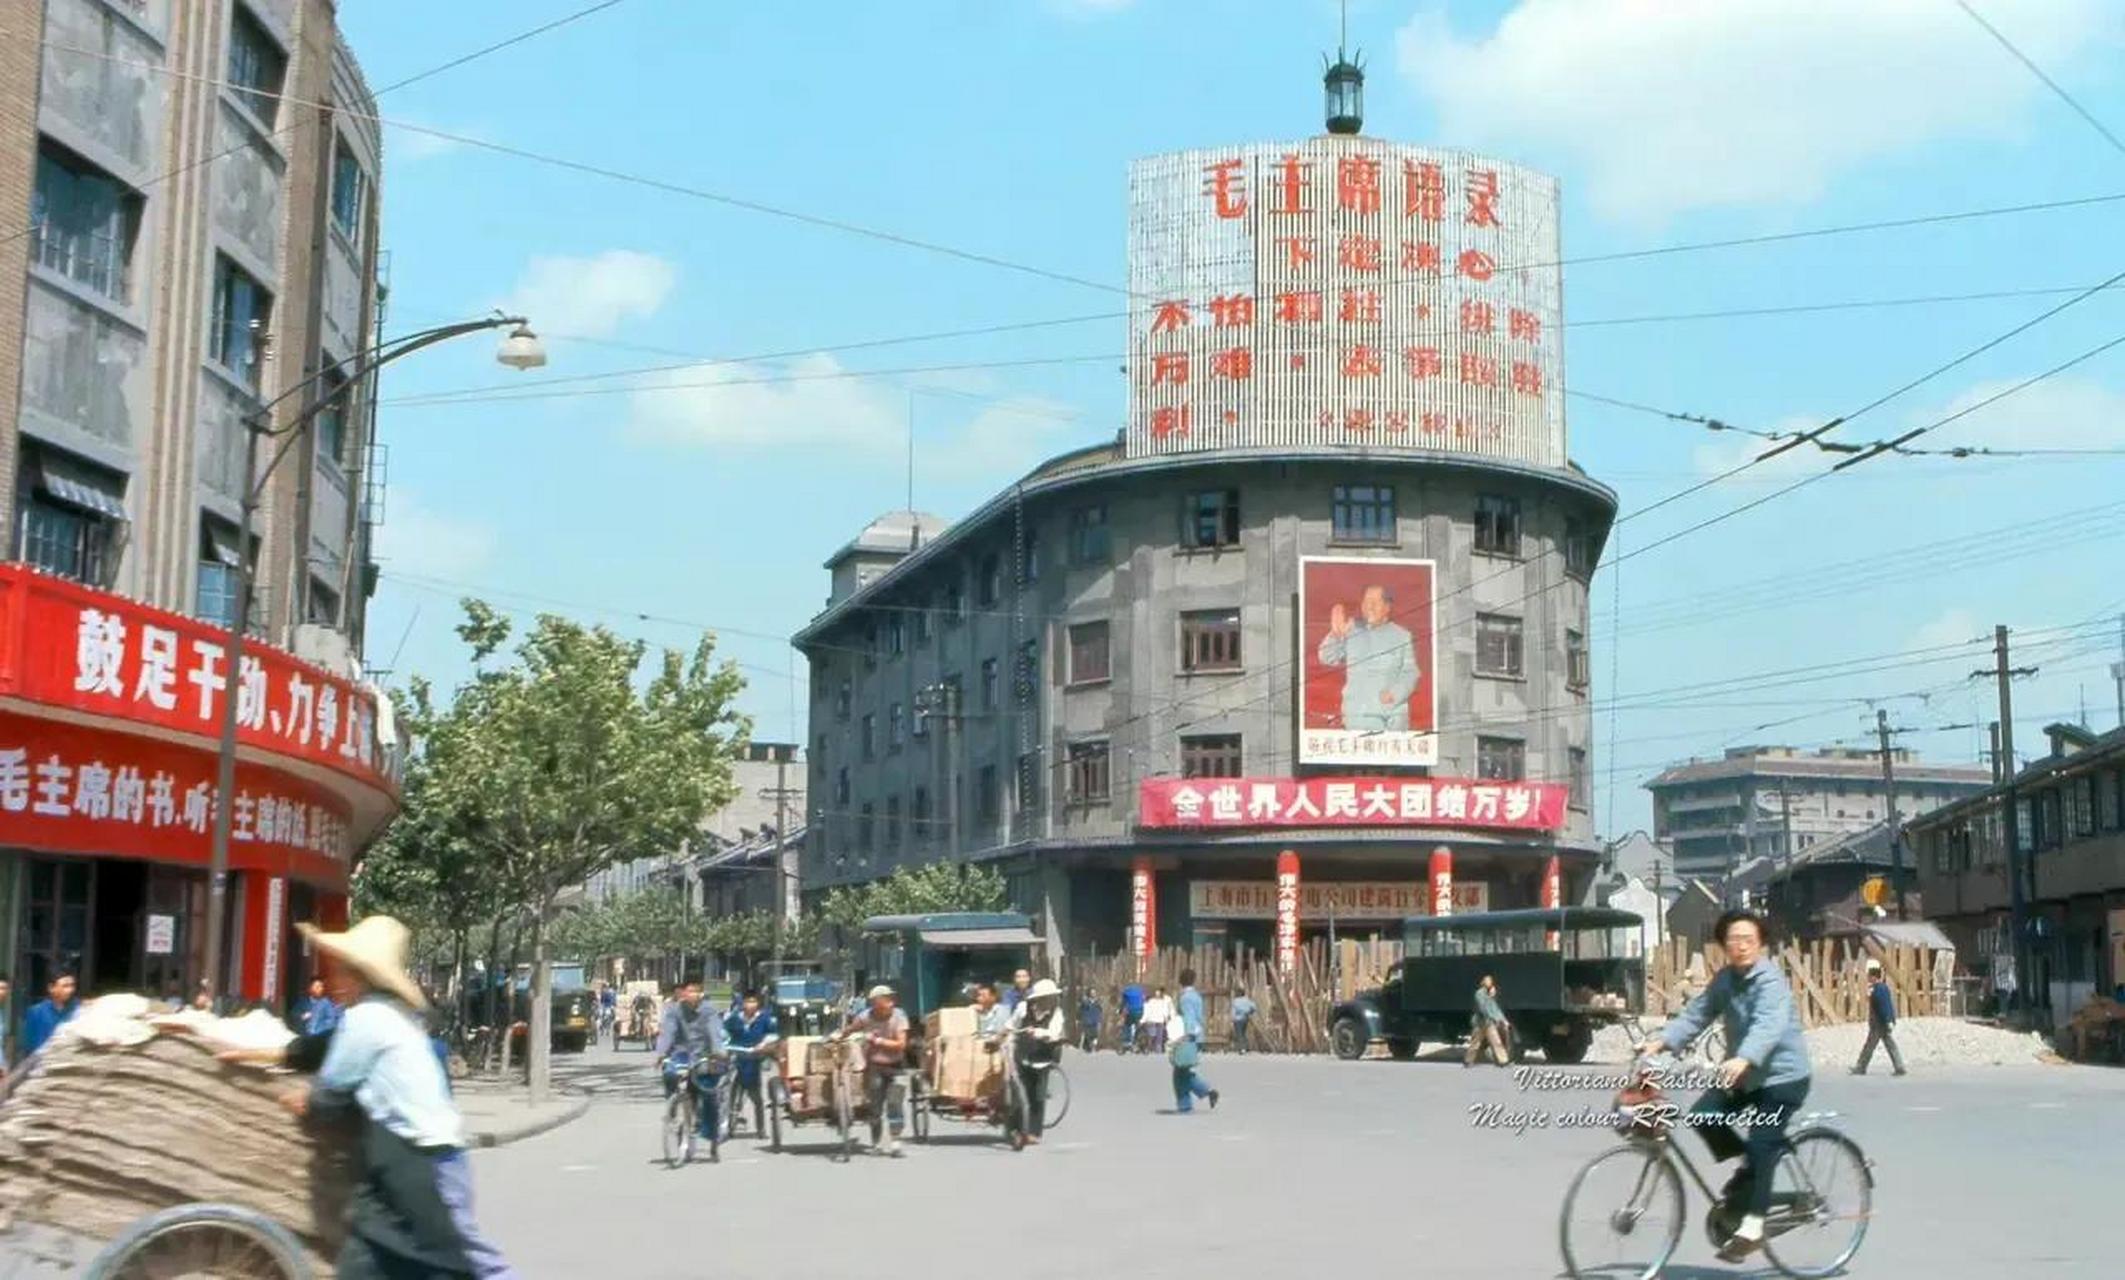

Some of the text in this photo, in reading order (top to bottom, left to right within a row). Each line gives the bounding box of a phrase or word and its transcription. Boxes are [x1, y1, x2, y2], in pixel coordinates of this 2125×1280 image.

[1202, 154, 1501, 228] 毛主席语录
[74, 607, 372, 765] 鼓足干劲、力争上
